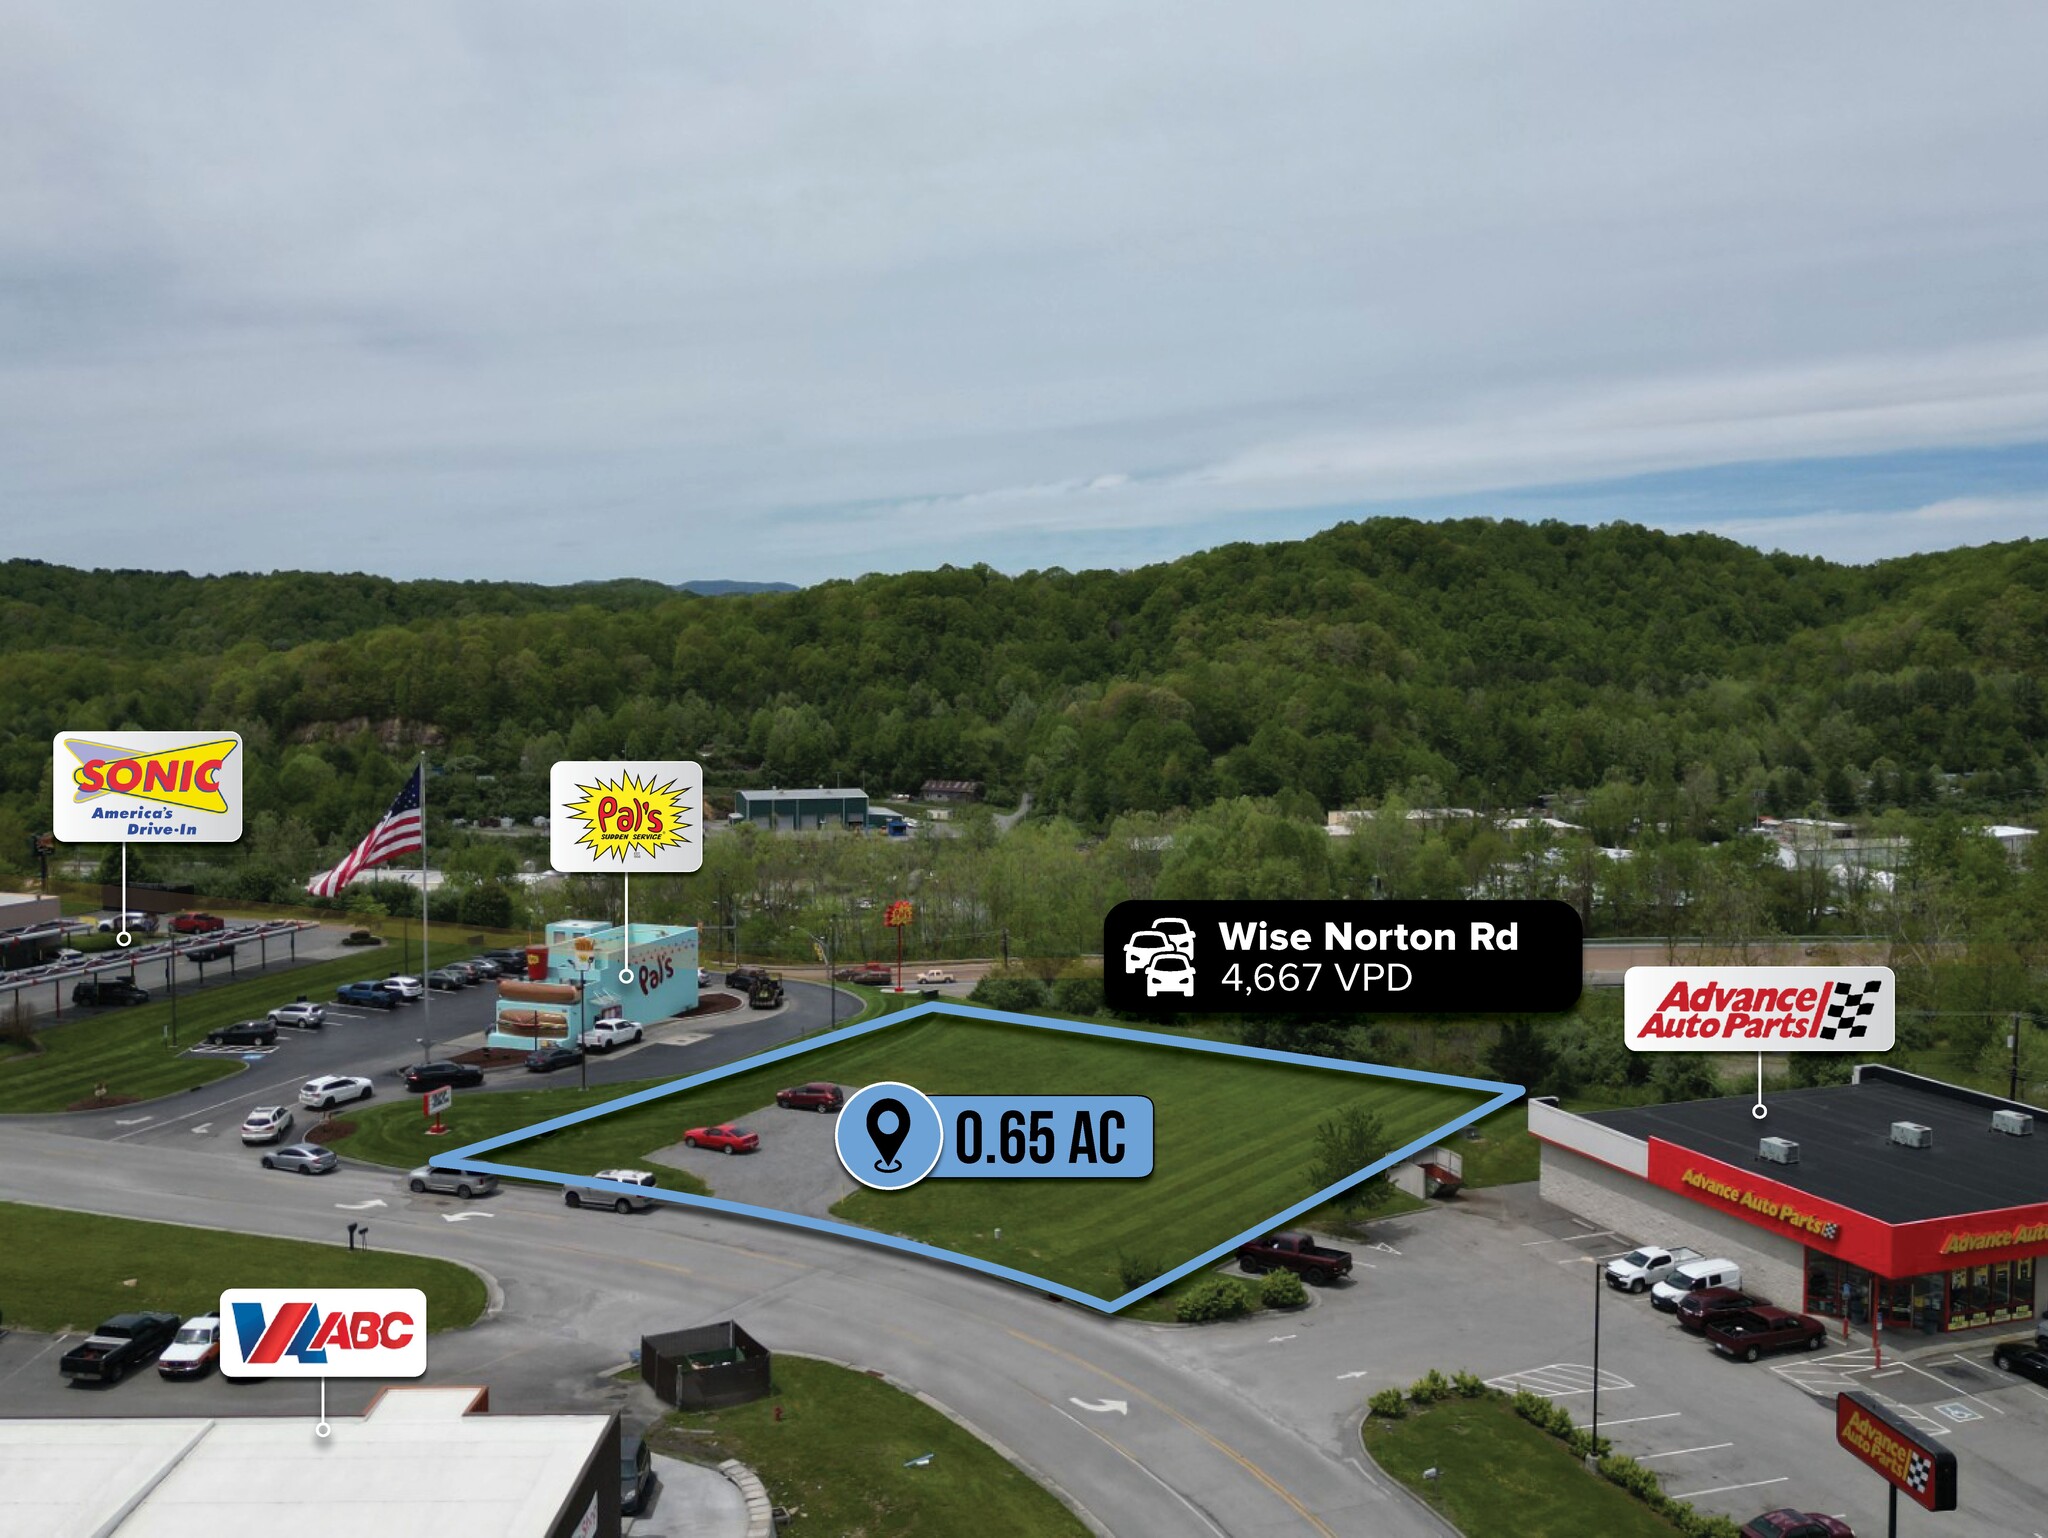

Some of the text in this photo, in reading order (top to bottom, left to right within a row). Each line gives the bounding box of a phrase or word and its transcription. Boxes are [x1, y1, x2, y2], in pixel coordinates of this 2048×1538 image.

[638, 954, 674, 996] Pal's
[1681, 1169, 1823, 1234] Advance Auto Parts
[1941, 1230, 2011, 1254] Advance
[1842, 1425, 1903, 1478] Auto Parts
[1848, 1411, 1906, 1459] Advance
